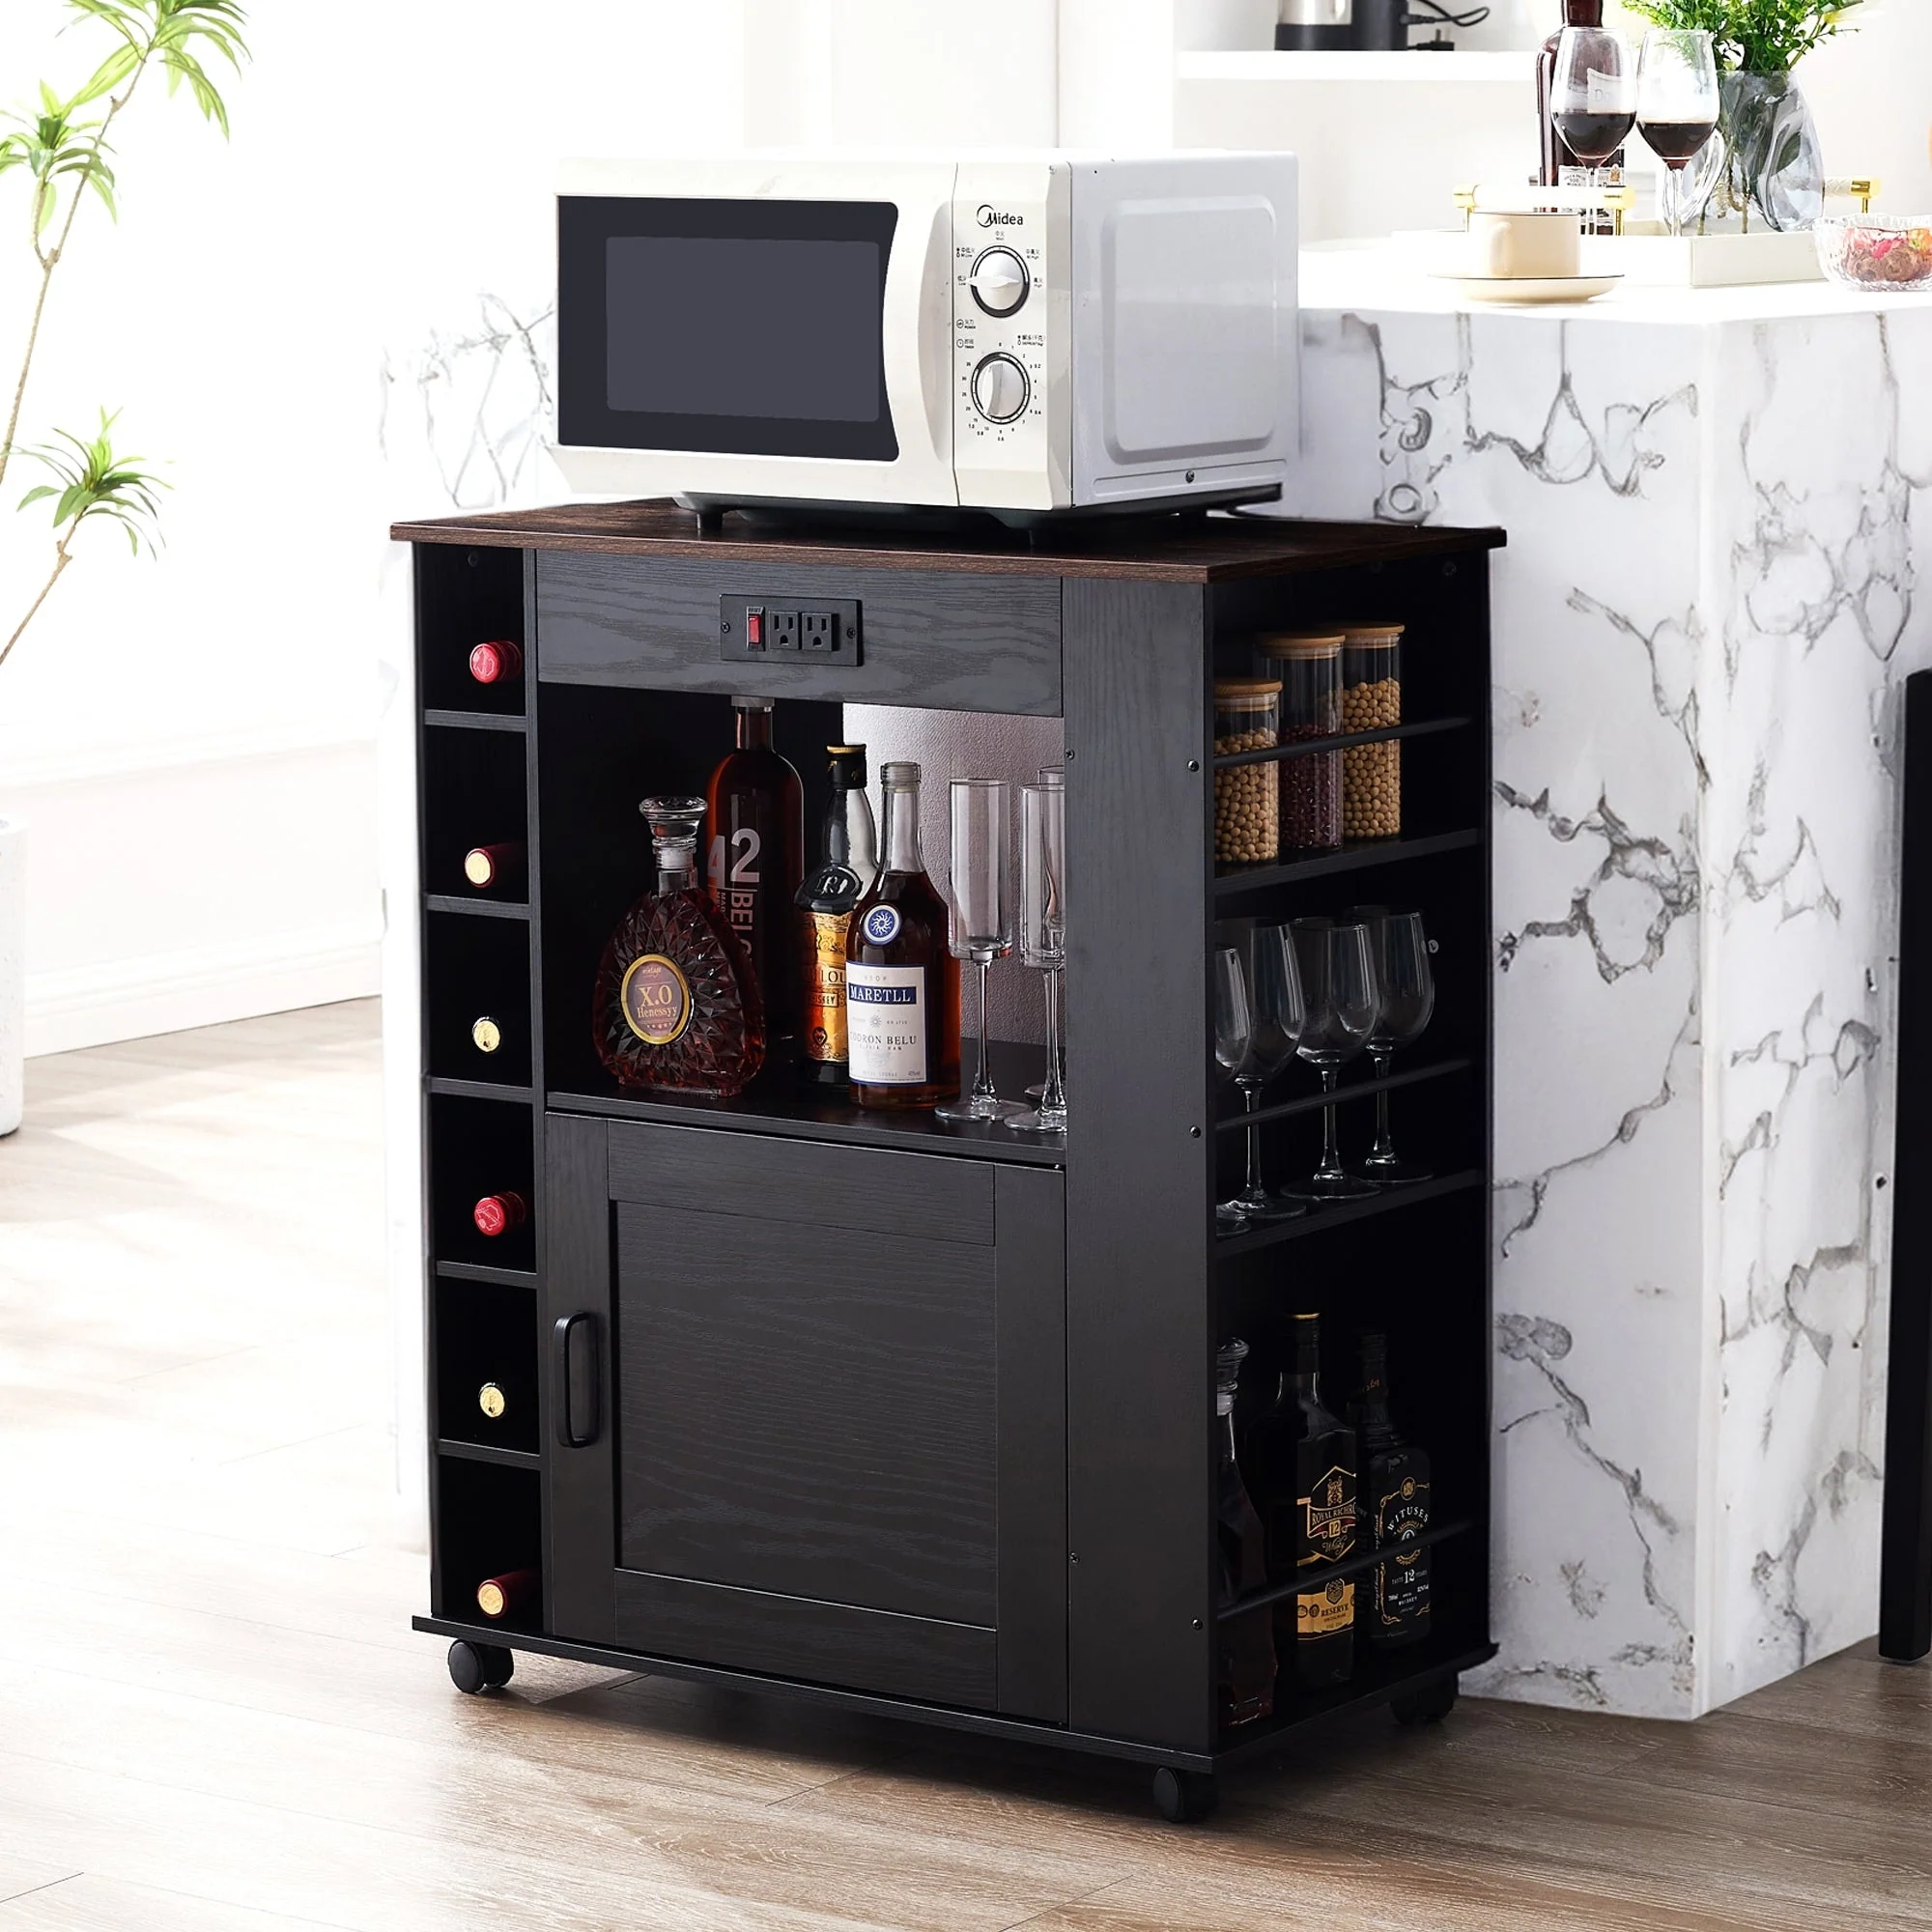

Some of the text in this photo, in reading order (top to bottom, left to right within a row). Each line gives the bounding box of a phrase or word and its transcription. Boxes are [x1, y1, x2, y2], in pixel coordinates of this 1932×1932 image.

[977, 204, 1024, 228] Midea
[849, 985, 911, 1003] MARETLL
[637, 1007, 678, 1019] Henessyy
[887, 1035, 917, 1045] BELU
[1387, 1506, 1430, 1531] WITUSES
[1404, 1569, 1415, 1584] 12
[1321, 1604, 1349, 1616] RESERVE
